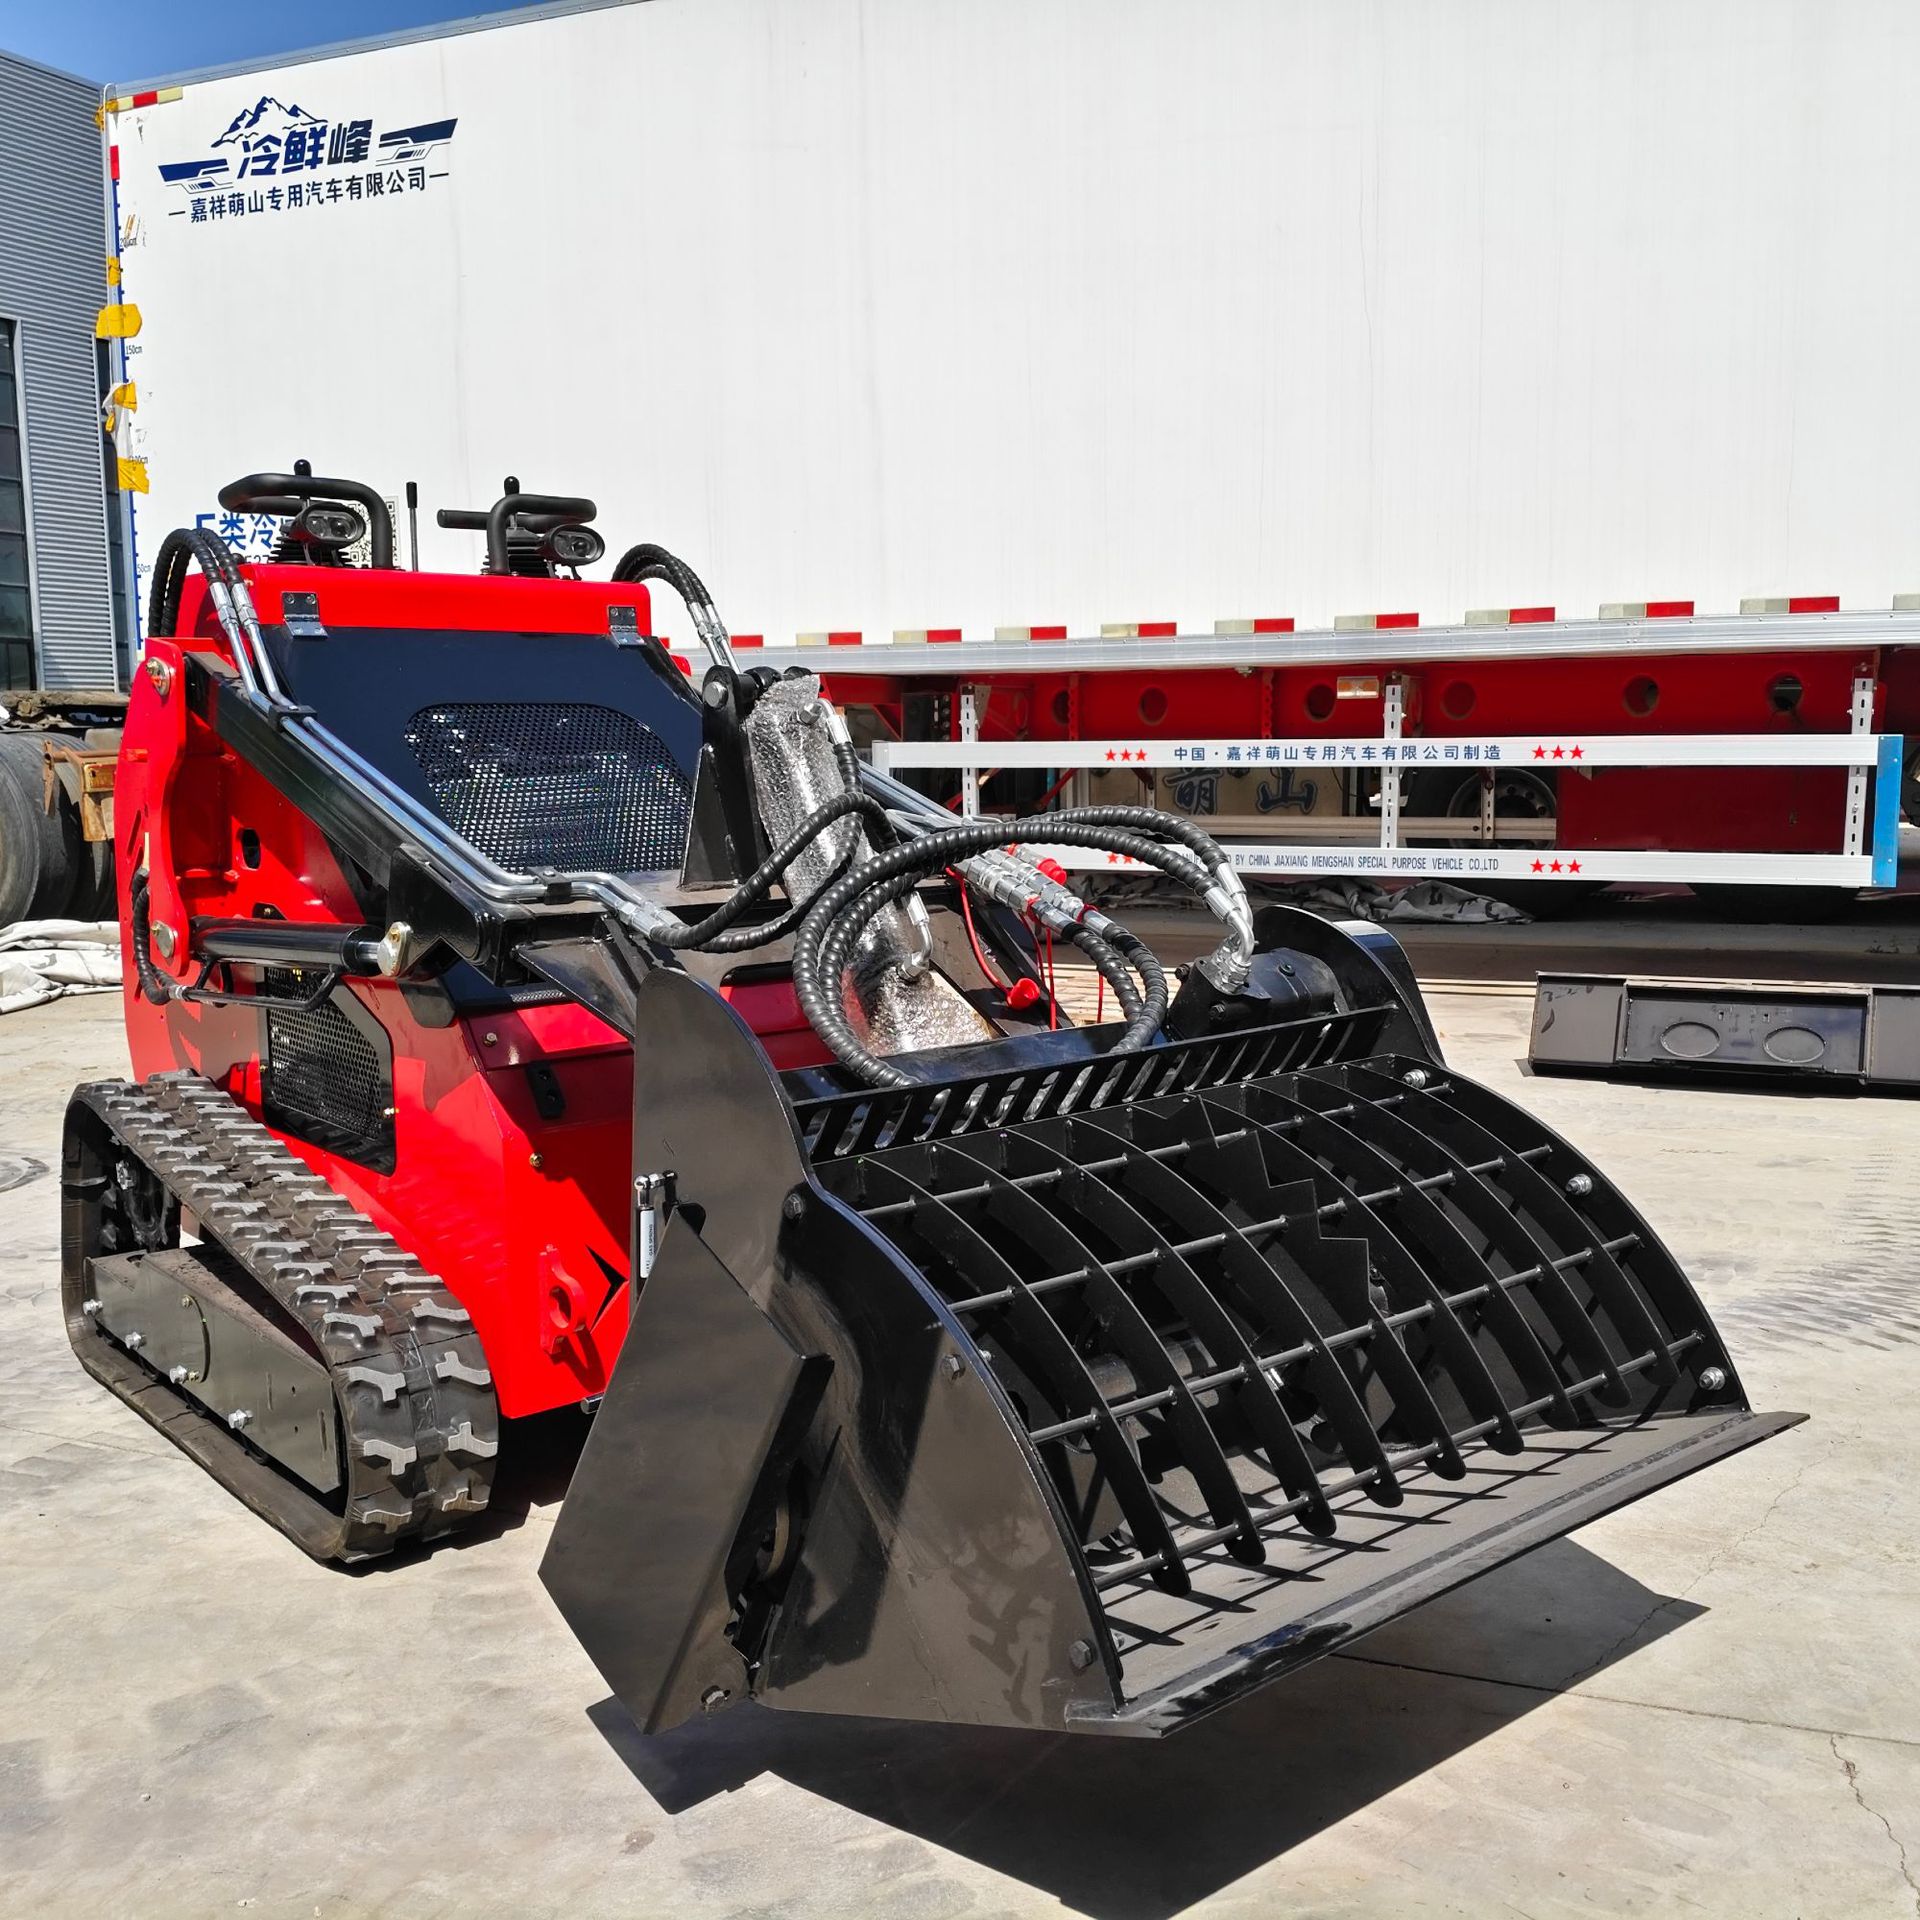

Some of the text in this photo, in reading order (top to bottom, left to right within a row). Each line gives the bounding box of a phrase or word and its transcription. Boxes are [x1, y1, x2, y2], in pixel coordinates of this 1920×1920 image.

[237, 119, 373, 179] 冷鲜峰
[190, 167, 426, 223] 嘉祥萌山专用汽车有限公司
[1235, 854, 1245, 866] BY
[1248, 854, 1270, 866] CHINA
[1274, 855, 1309, 867] JIAXIANG
[1311, 856, 1354, 868] MENGSHAN
[1357, 856, 1388, 869] SPECIAL
[1392, 857, 1427, 870] PURPOSE
[1431, 857, 1464, 870] VEHICLE
